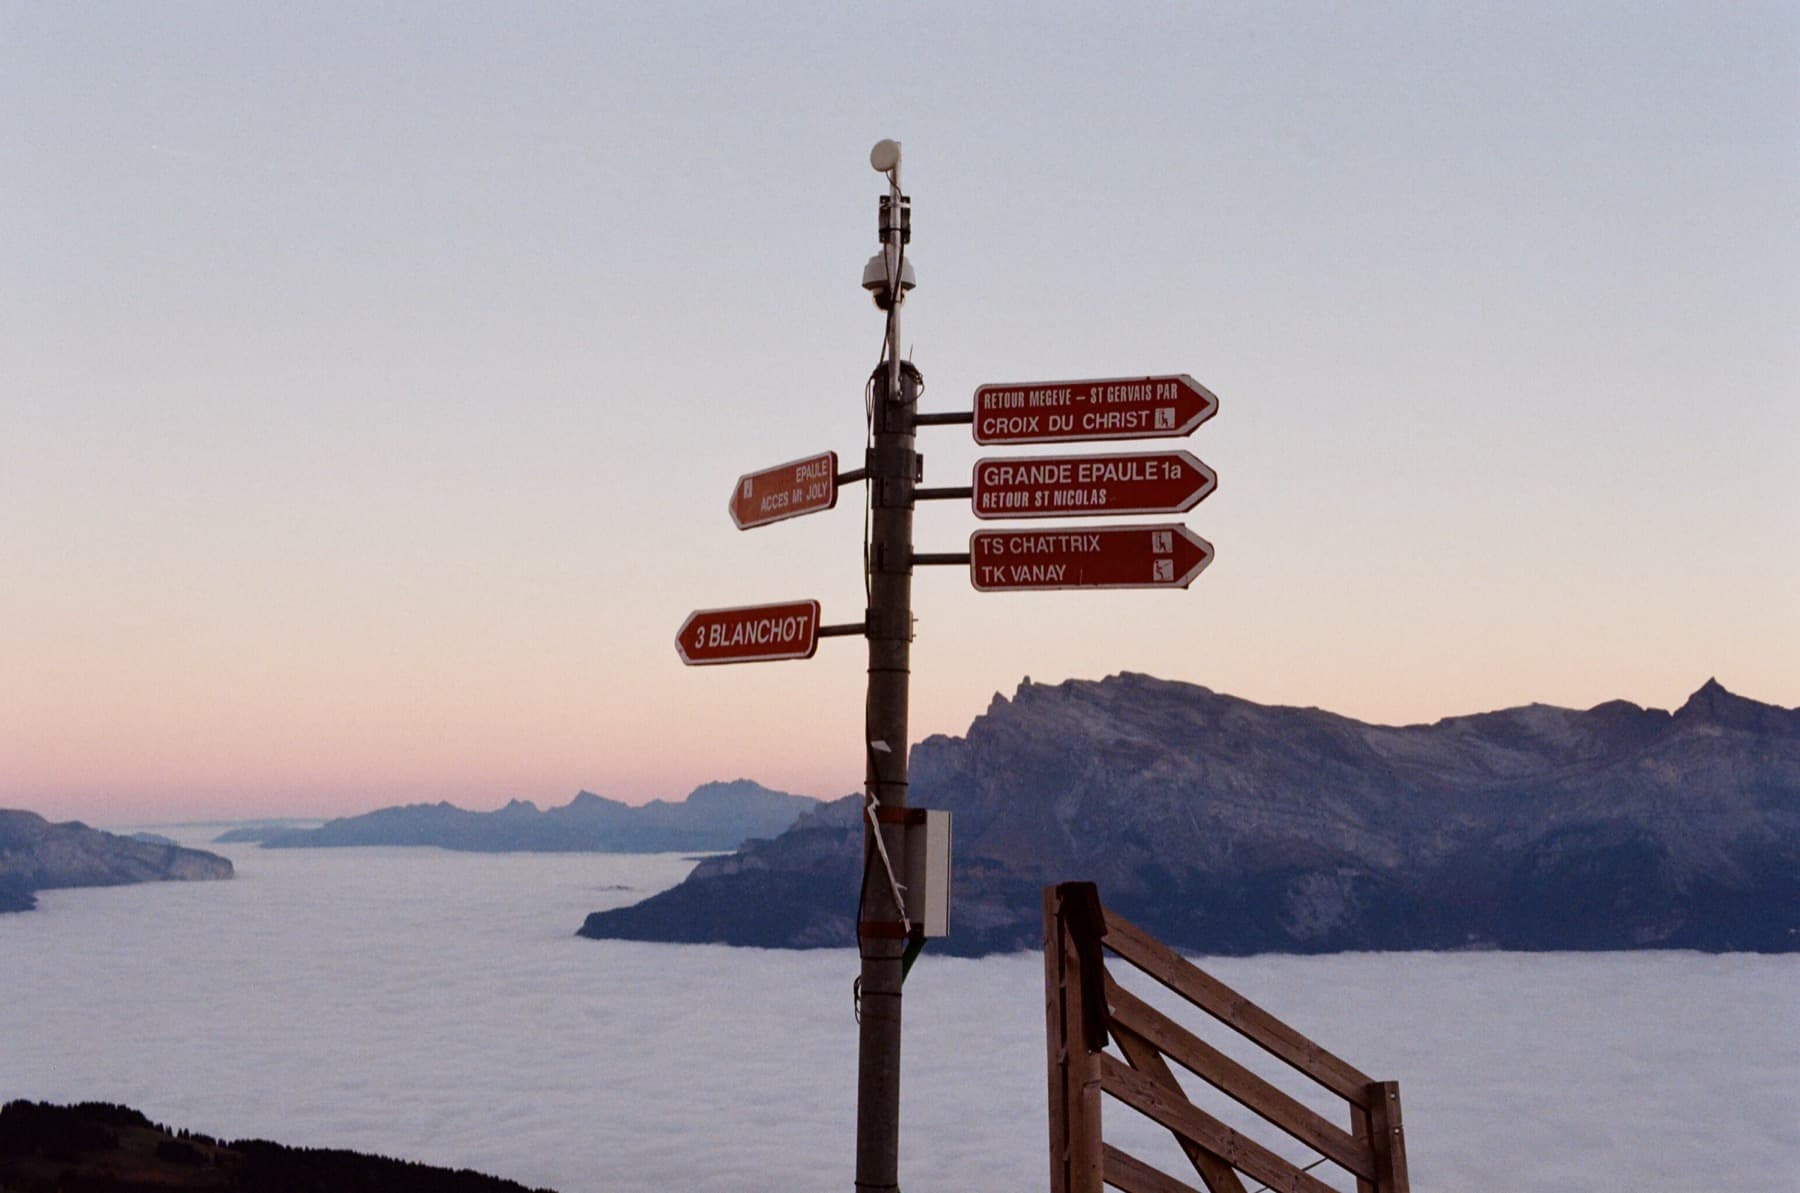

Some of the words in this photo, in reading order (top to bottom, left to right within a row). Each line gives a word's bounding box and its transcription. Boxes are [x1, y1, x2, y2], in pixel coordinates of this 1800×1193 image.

[984, 391, 1025, 409] RETOUR
[1029, 388, 1072, 406] MEGEVE
[1090, 386, 1104, 404] ST
[1107, 384, 1152, 402] GERVAIS
[1157, 383, 1178, 400] PAR
[983, 415, 1039, 434] CROIX
[1049, 413, 1073, 431] DU
[1082, 410, 1150, 429] CHRIST
[796, 459, 828, 483] EPAULE
[984, 464, 1072, 486] GRANDE
[1078, 461, 1158, 482] EPAULE
[1162, 461, 1182, 480] 1a
[760, 491, 789, 512] ACCES
[806, 481, 828, 501] JOLY
[982, 491, 1029, 508] RETOUR
[1035, 490, 1049, 507] ST
[1053, 489, 1107, 506] NICOLAS
[980, 537, 1004, 555] TS
[1009, 535, 1101, 554] CHATTRIX
[981, 565, 1006, 583] TK
[1010, 564, 1067, 582] VANAY
[695, 626, 705, 649] 3
[709, 615, 808, 647] BLANCHOT
